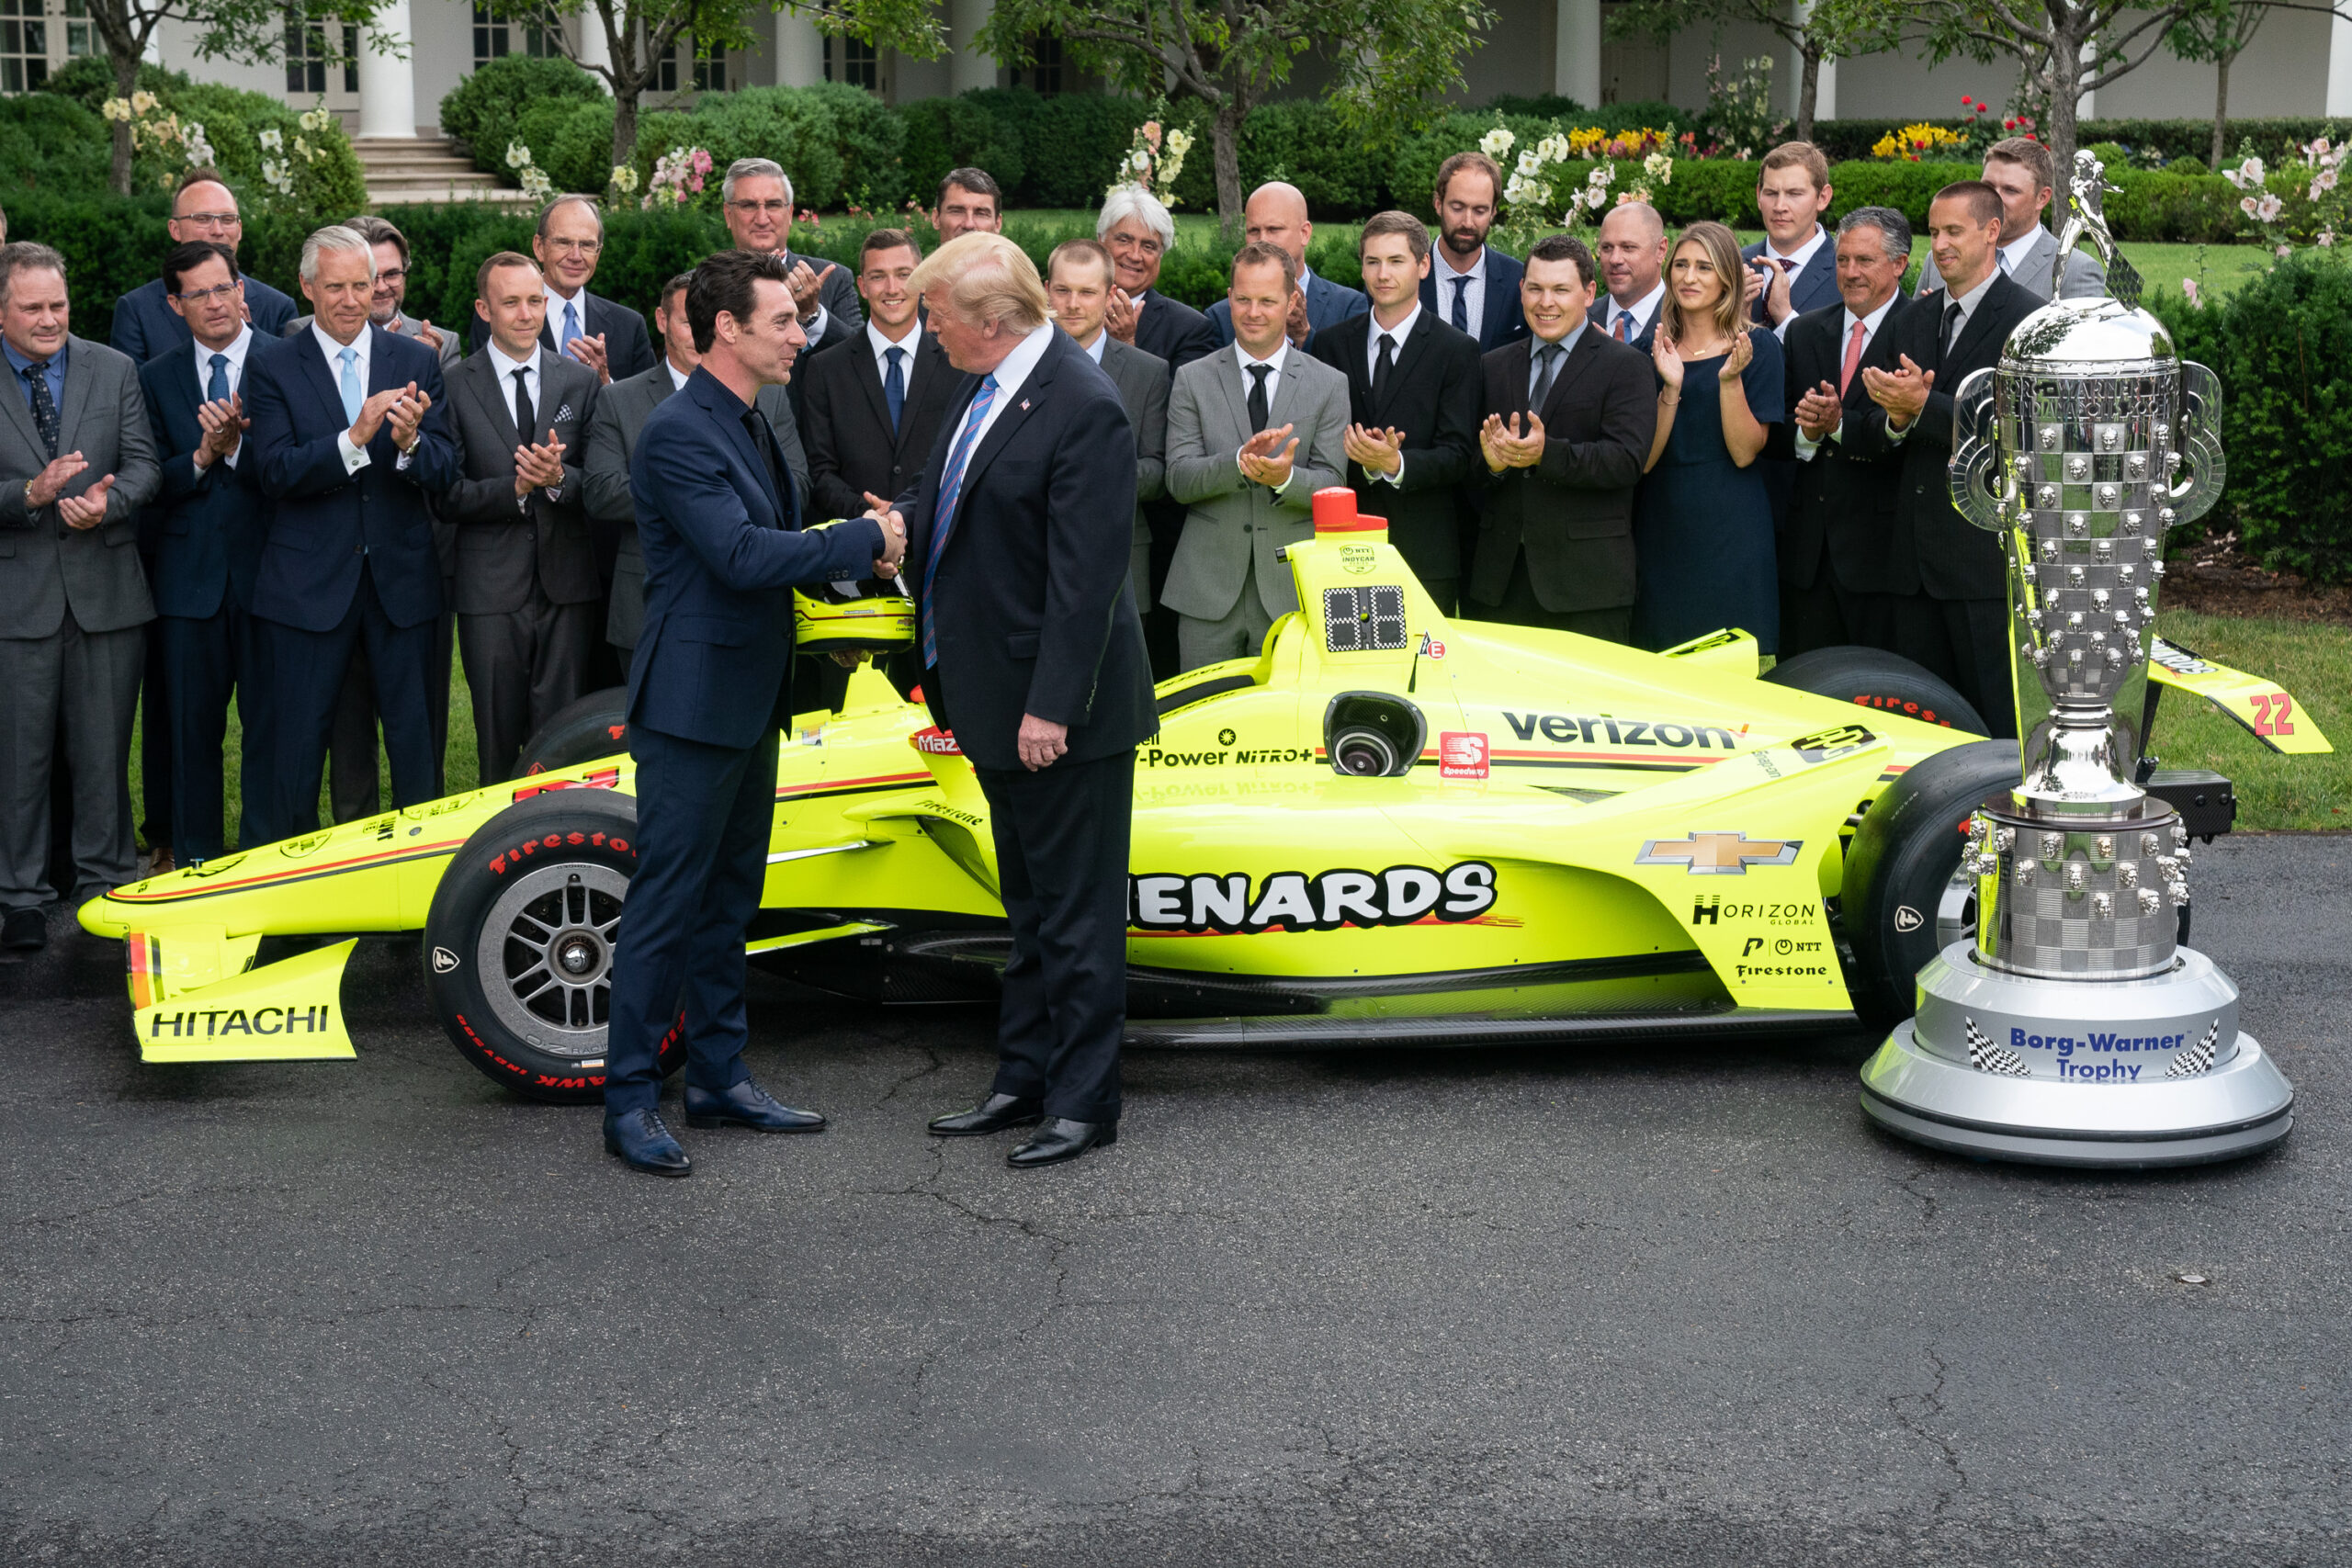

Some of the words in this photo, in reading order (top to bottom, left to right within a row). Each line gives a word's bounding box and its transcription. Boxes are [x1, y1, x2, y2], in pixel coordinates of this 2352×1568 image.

[2250, 694, 2294, 736] 22
[918, 735, 960, 752] Maz
[1501, 712, 1736, 750] verizon
[1135, 749, 1228, 767] -Power
[1443, 766, 1486, 776] Speedway
[489, 830, 638, 875] Firesto
[1128, 861, 1497, 933] ENARDS
[1692, 895, 1815, 925] HORIZON
[1796, 942, 1822, 952] NTT
[1736, 965, 1827, 977] Firestone
[152, 1005, 328, 1037] HITACHI
[2056, 1058, 2143, 1080] Trophy
